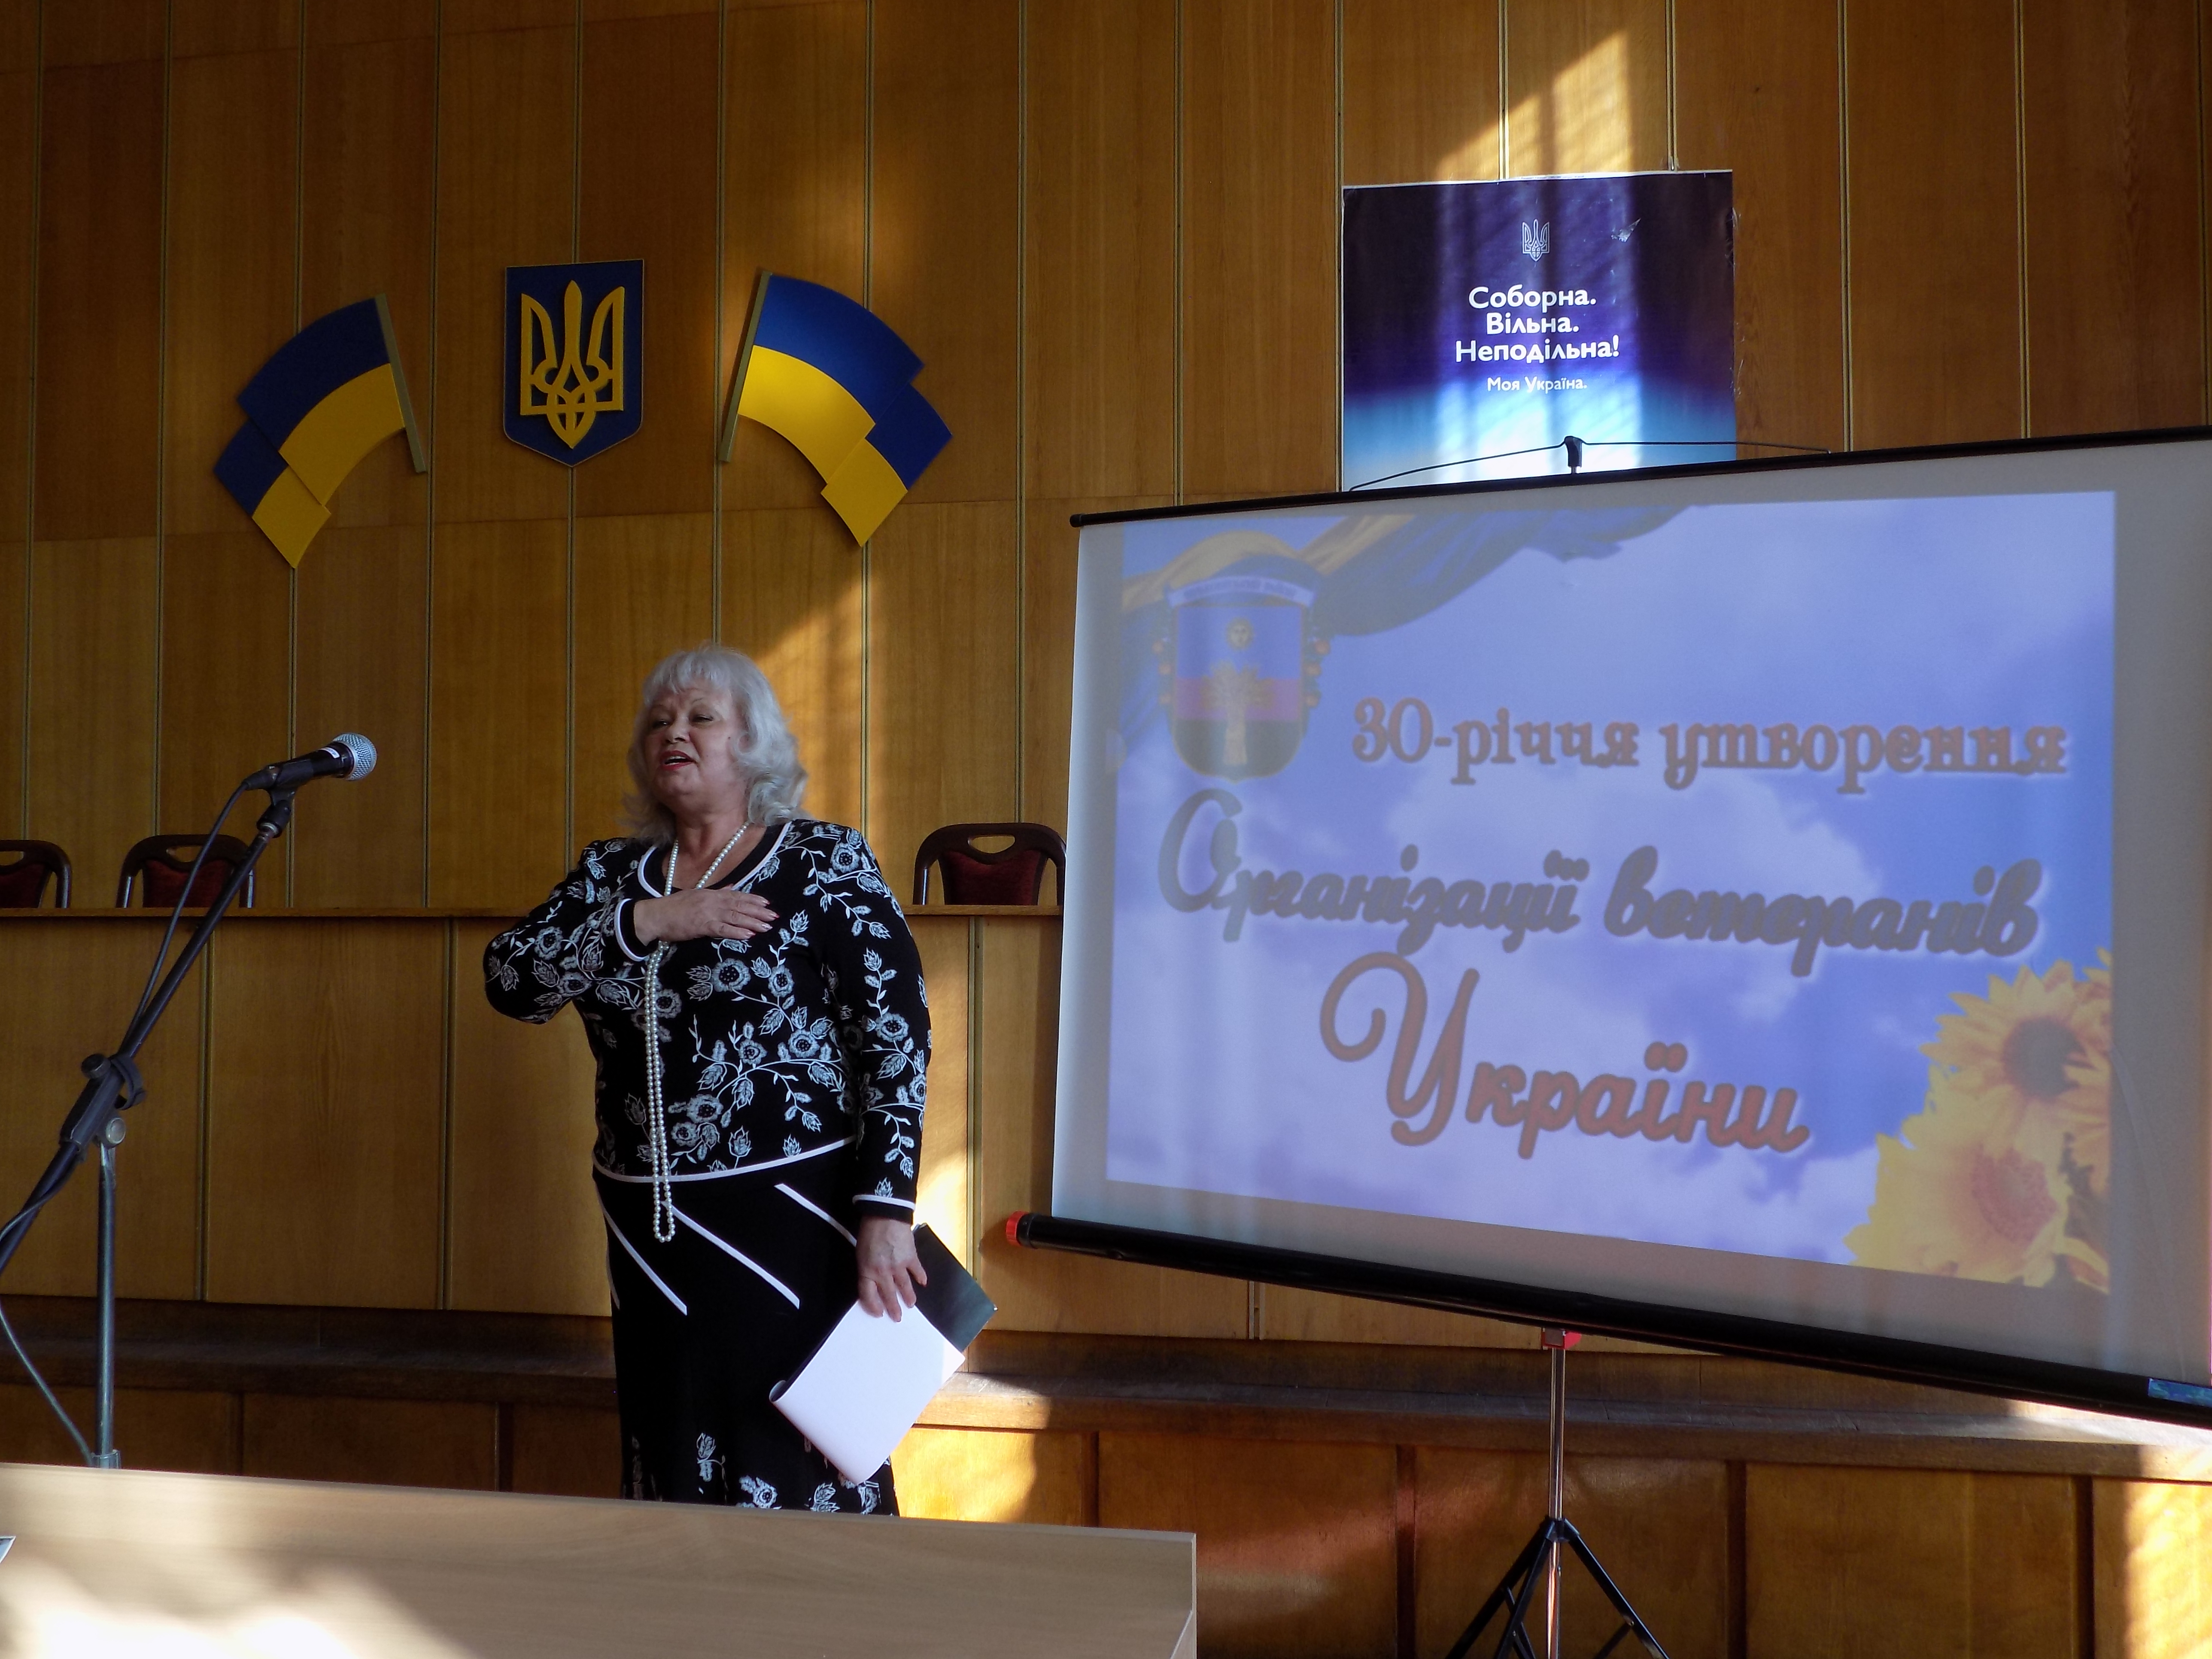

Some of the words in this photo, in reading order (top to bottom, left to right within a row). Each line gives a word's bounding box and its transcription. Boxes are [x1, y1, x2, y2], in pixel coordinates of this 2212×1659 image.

[1468, 284, 1597, 313] Соборна.
[1486, 312, 1579, 334] Вільна.
[1455, 334, 1620, 363] Неподільна!
[1487, 377, 1520, 391] Моя
[1525, 376, 1587, 394] Україна.
[1352, 696, 1640, 785] 30-річчя
[1659, 722, 2067, 794] утворення
[1158, 787, 1589, 954] Організації
[1603, 845, 2042, 978] ветеранів
[1320, 951, 1810, 1160] України
